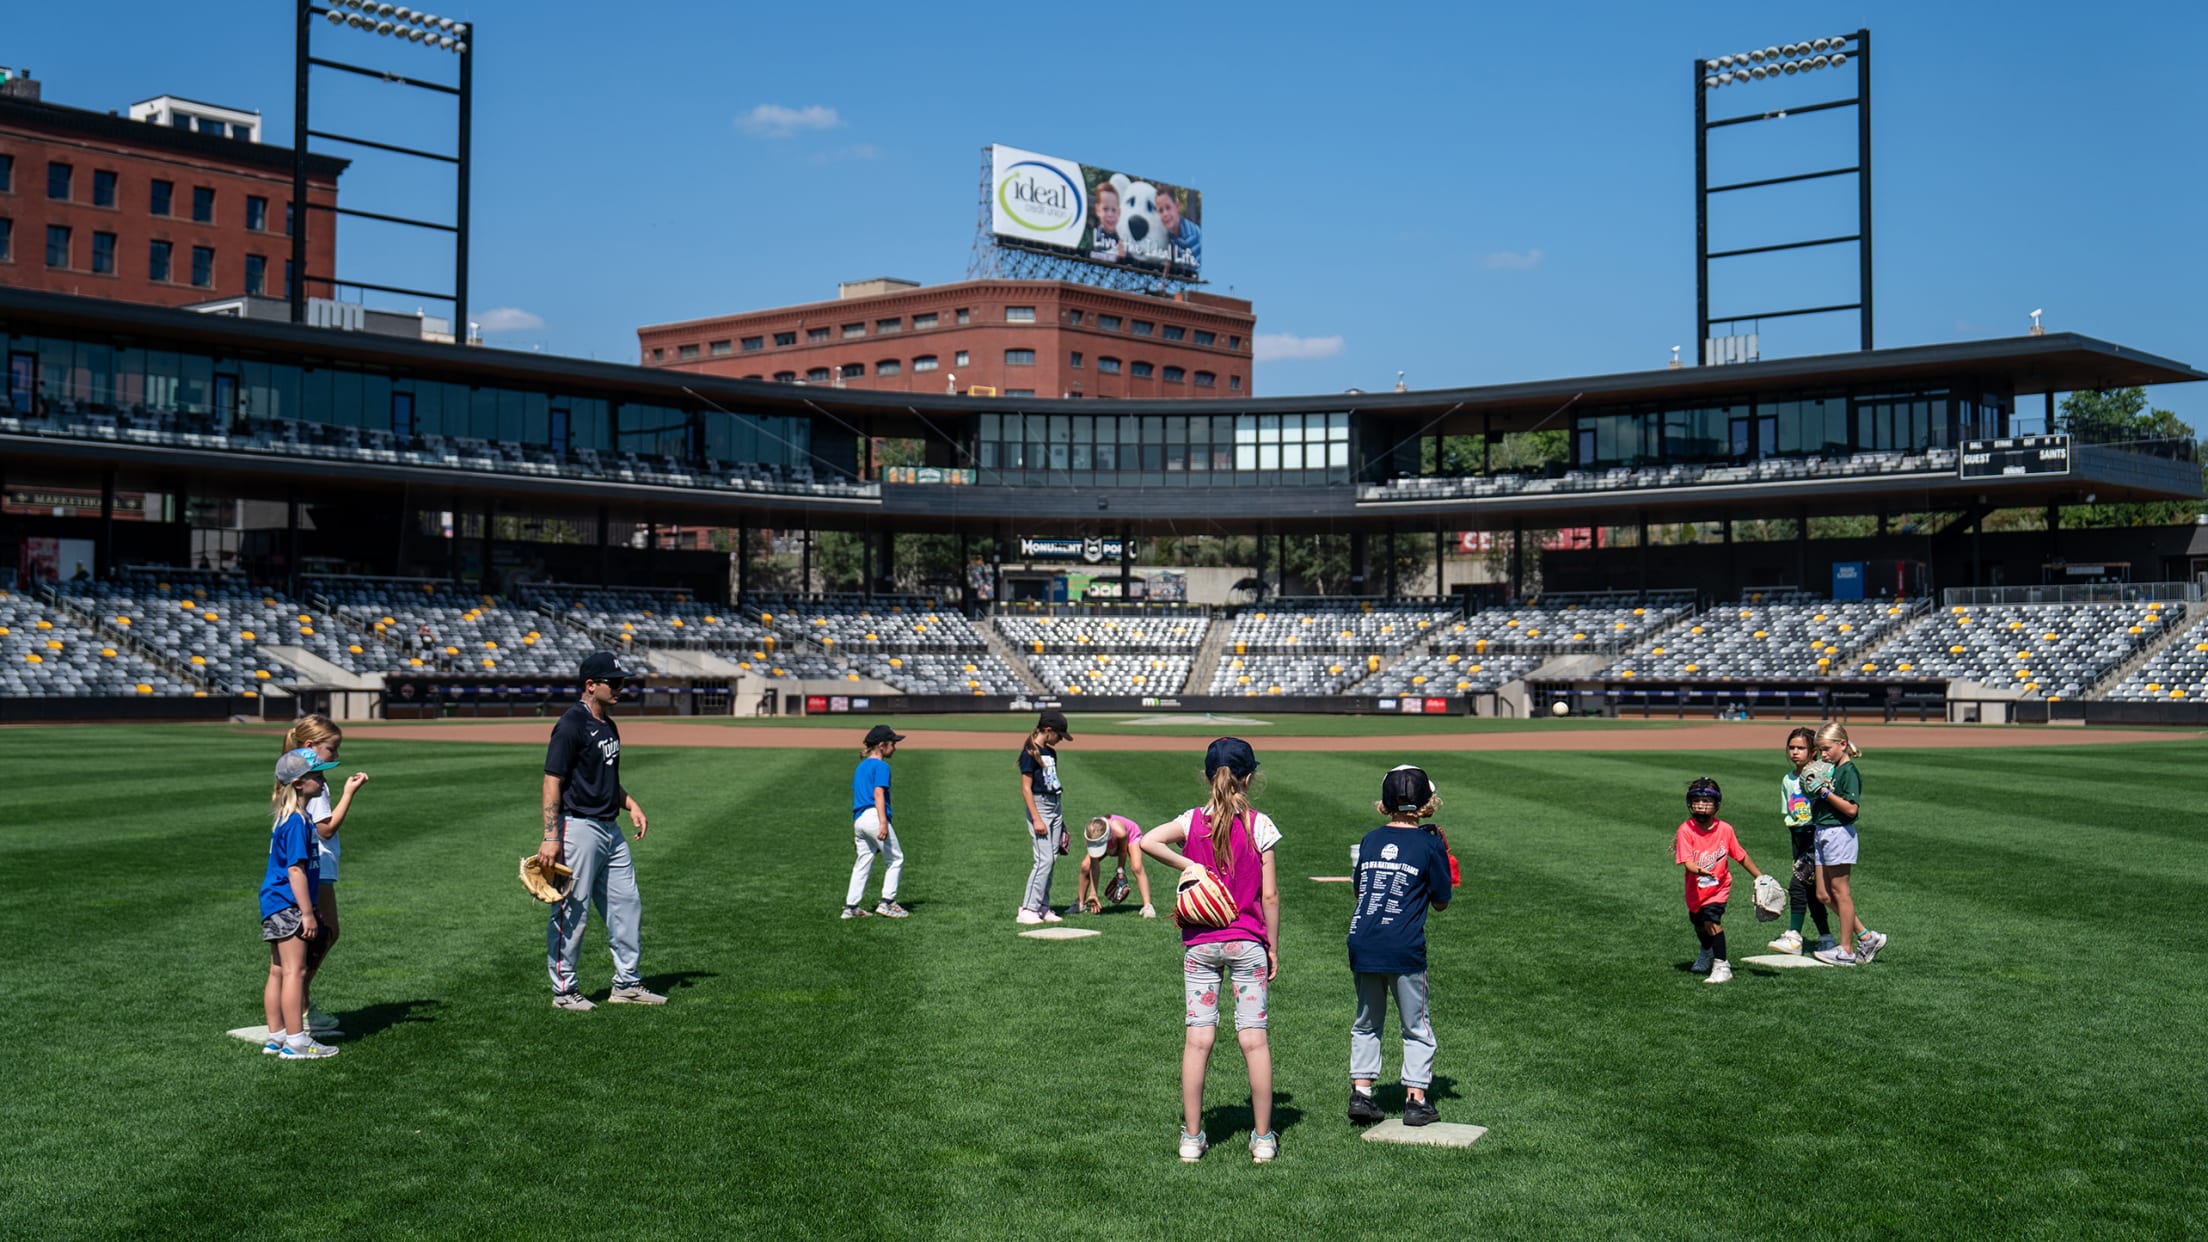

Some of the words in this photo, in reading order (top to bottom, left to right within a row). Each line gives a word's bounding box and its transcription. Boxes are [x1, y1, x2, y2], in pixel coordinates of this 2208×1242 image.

[1014, 177, 1066, 208] ideal
[1093, 228, 1119, 250] Live
[1963, 453, 1991, 465] GUEST
[2039, 448, 2066, 461] SAINTS
[598, 738, 620, 761] Twin
[1402, 863, 1419, 876] TEAMS
